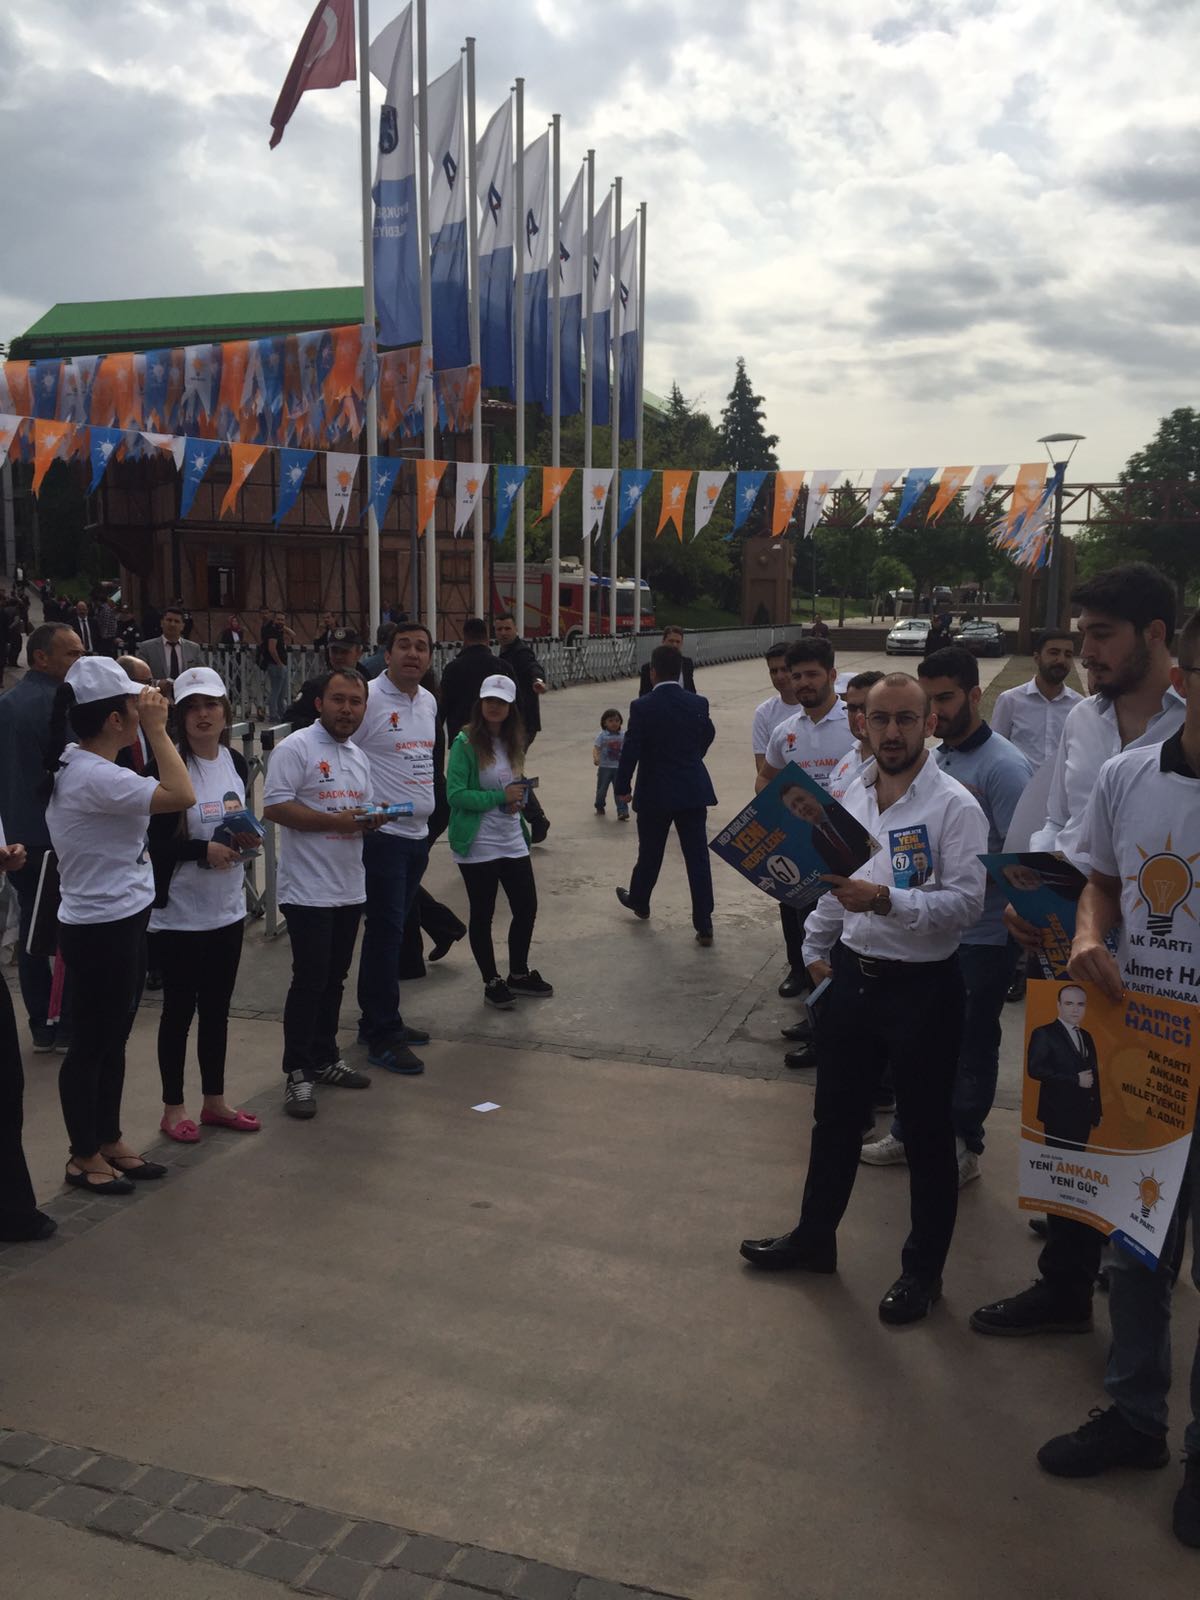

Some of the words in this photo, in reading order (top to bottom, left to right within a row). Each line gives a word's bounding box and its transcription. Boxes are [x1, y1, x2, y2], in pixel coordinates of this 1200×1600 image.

[319, 790, 346, 800] SADIK
[768, 856, 800, 887] 67
[896, 856, 906, 869] 67
[1130, 934, 1145, 946] AK
[1124, 958, 1173, 982] Ahmet
[1156, 988, 1198, 1003] ANKARA
[1128, 1001, 1191, 1030] Ahmet
[1147, 1050, 1161, 1062] AK
[1162, 1056, 1191, 1074] PARTİ
[1150, 1066, 1189, 1088] ANKARA
[1121, 1082, 1186, 1115] MİLLETVEKİLİ
[1029, 1160, 1053, 1171] YENİ
[1056, 1161, 1110, 1187] ANKARA
[1050, 1174, 1074, 1188] YENİ
[1077, 1180, 1098, 1197] GÜÇ
[1130, 1212, 1138, 1223] AK
